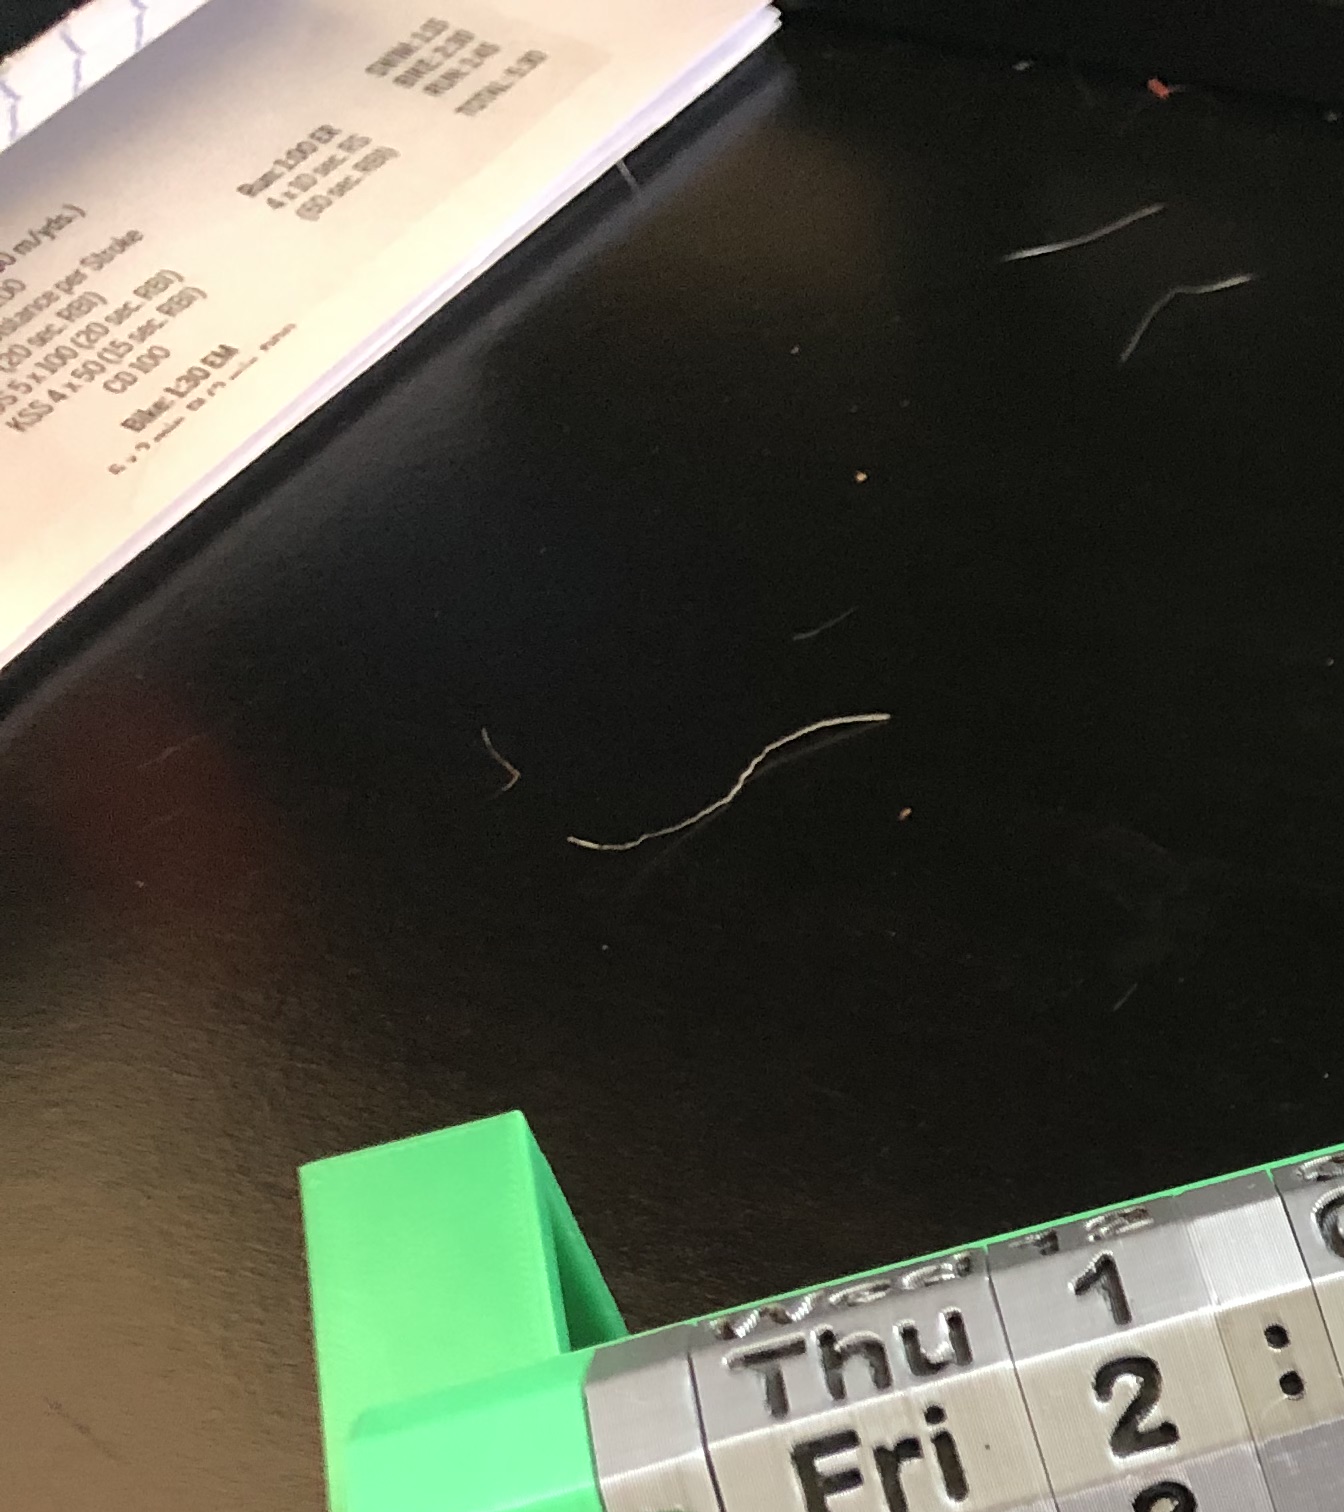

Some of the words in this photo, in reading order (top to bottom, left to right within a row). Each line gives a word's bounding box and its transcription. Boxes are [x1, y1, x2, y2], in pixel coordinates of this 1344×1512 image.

[34, 345, 78, 374] 100
[70, 322, 110, 350] (20
[71, 360, 106, 382] 50
[128, 345, 171, 374] 100
[722, 1303, 975, 1418] Thu
[1068, 1252, 1135, 1326] 1
[1091, 1355, 1182, 1460] 2
